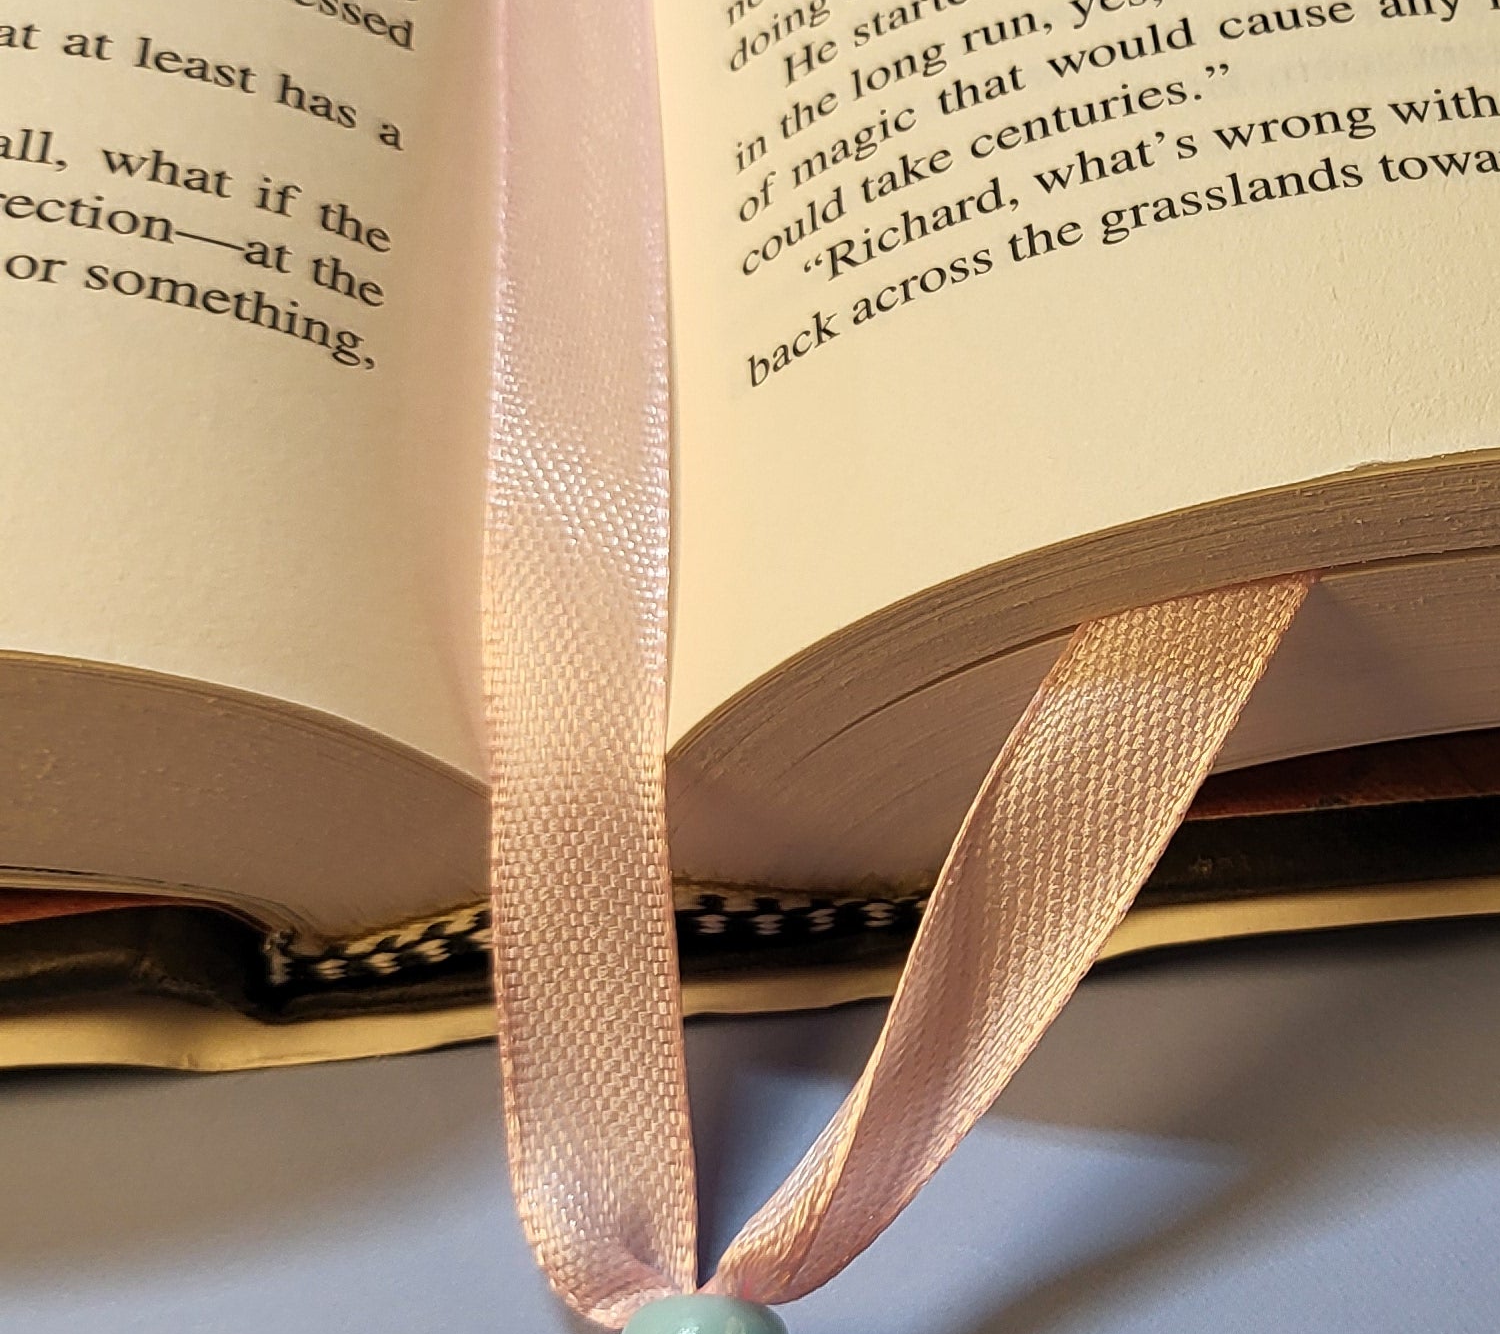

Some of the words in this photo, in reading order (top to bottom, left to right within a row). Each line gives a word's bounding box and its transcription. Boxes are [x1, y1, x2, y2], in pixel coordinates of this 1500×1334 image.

[61, 34, 114, 61] at
[133, 36, 257, 94] least
[275, 72, 357, 129] has
[377, 122, 404, 152] a
[735, 135, 767, 173] in
[779, 92, 837, 140] the
[850, 42, 947, 100] long
[961, 12, 1053, 54] run,
[738, 170, 777, 223] of
[791, 108, 917, 188] magic
[937, 64, 1026, 116] that
[1046, 16, 1196, 78] would
[1219, 1, 1355, 40] cause
[783, 40, 837, 86] He
[101, 148, 233, 199] what
[255, 176, 303, 218] if
[319, 203, 391, 253] the
[741, 185, 847, 276] could
[860, 149, 953, 204] take
[970, 63, 1229, 159] centuries.”
[803, 176, 1019, 282] “Richard,
[1032, 131, 1198, 194] what’s
[1212, 107, 1377, 151] wrong
[3, 254, 68, 284] or
[83, 265, 375, 370] something,
[311, 256, 385, 308] the
[747, 311, 841, 388] back
[852, 248, 993, 326] across
[1007, 221, 1084, 262] the
[1101, 156, 1364, 246] grasslands
